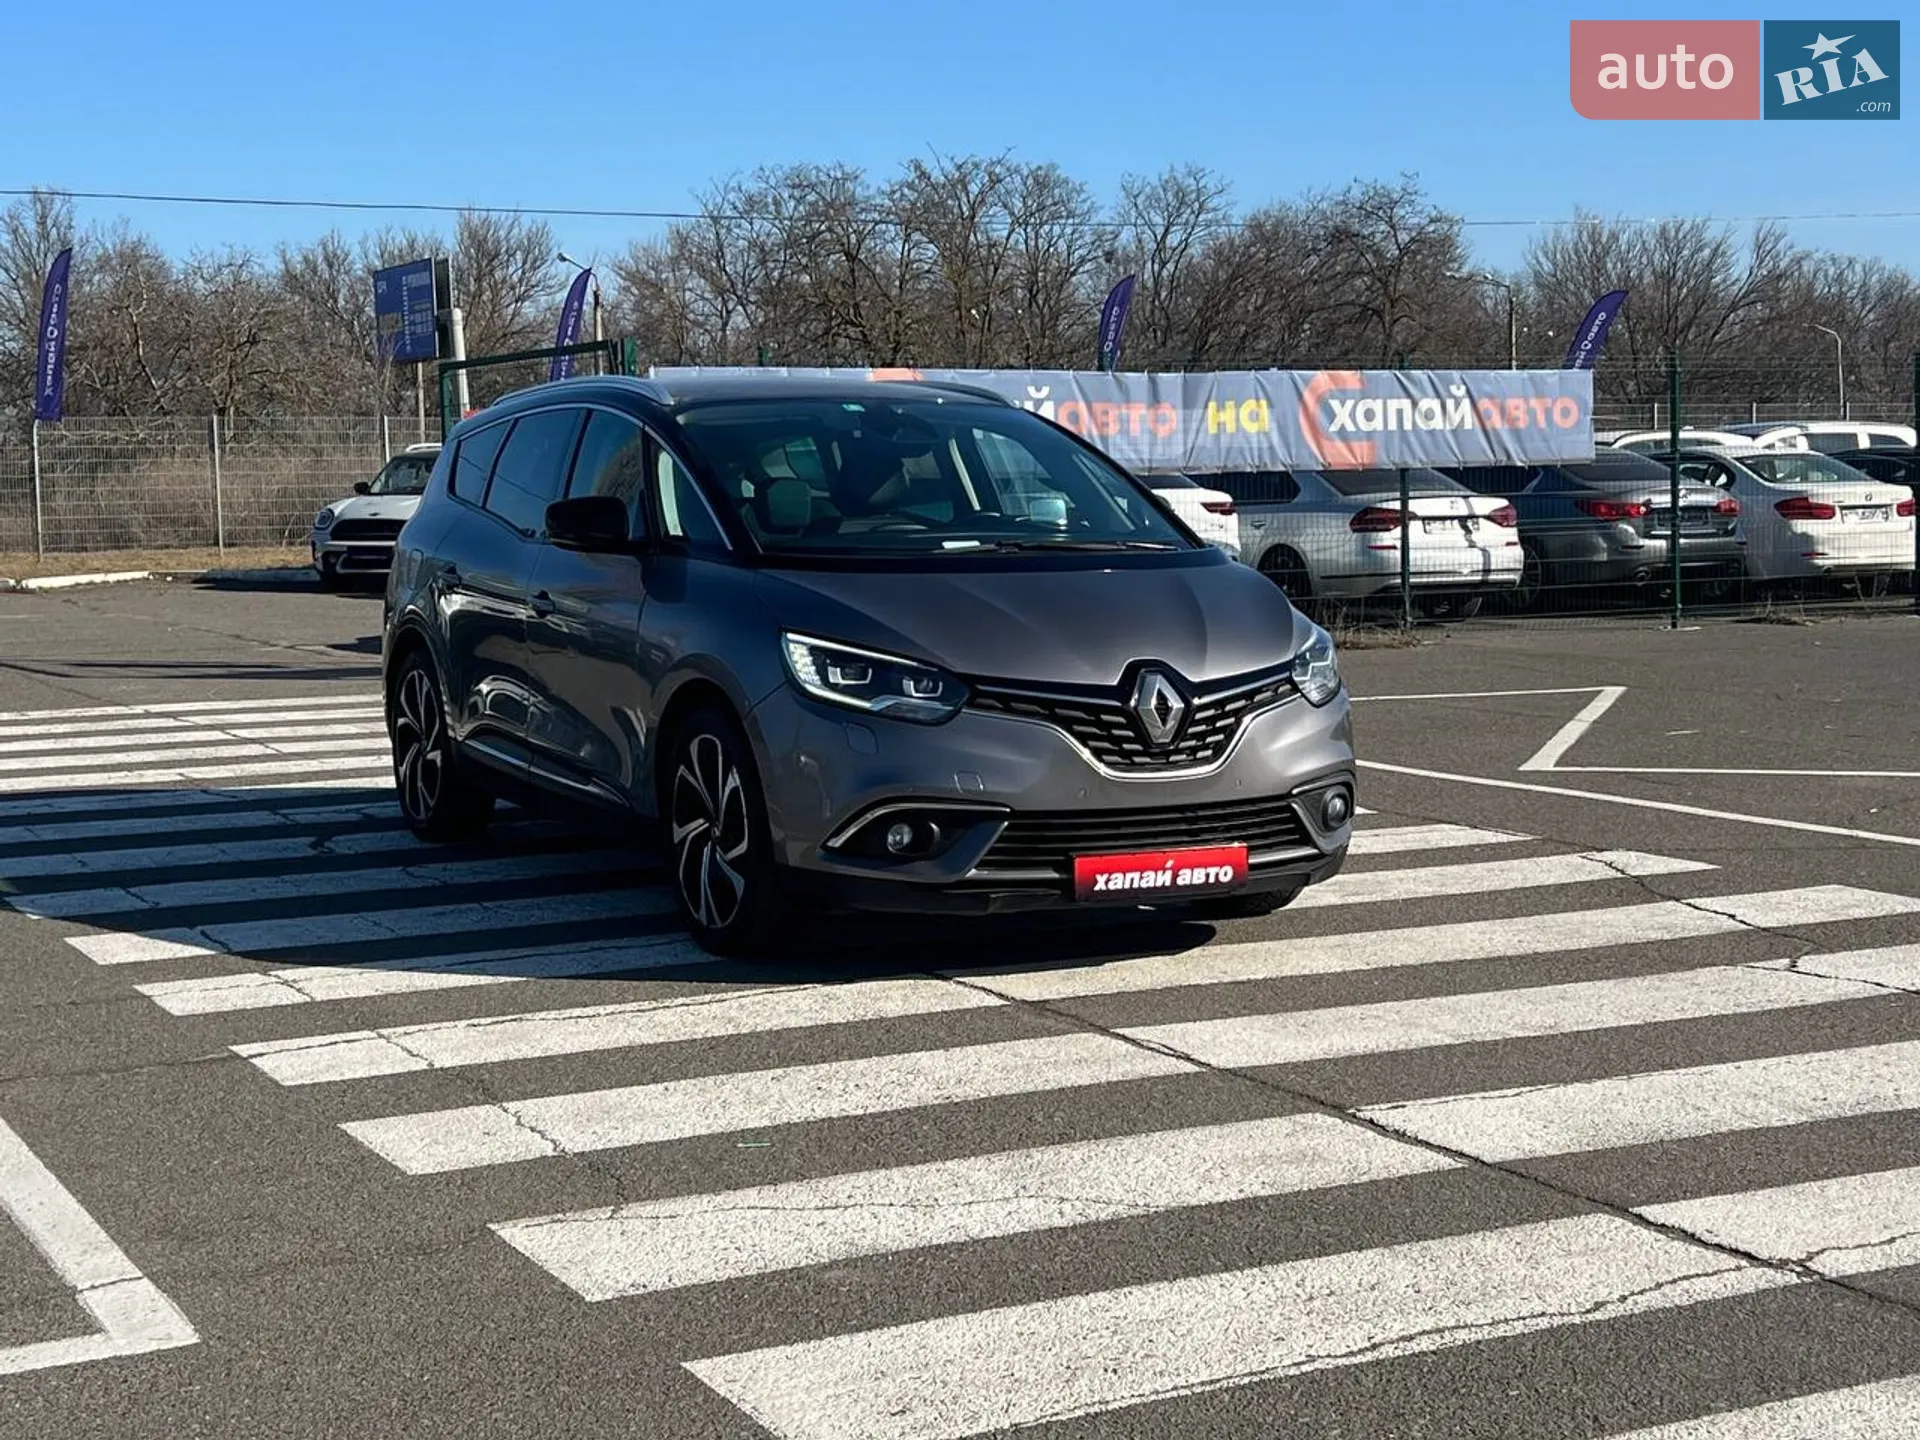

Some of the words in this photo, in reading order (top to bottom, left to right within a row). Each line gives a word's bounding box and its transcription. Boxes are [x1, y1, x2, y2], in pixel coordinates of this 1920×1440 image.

[1587, 312, 1607, 341] авто
[1207, 398, 1270, 434] на
[1176, 865, 1234, 886] авто
